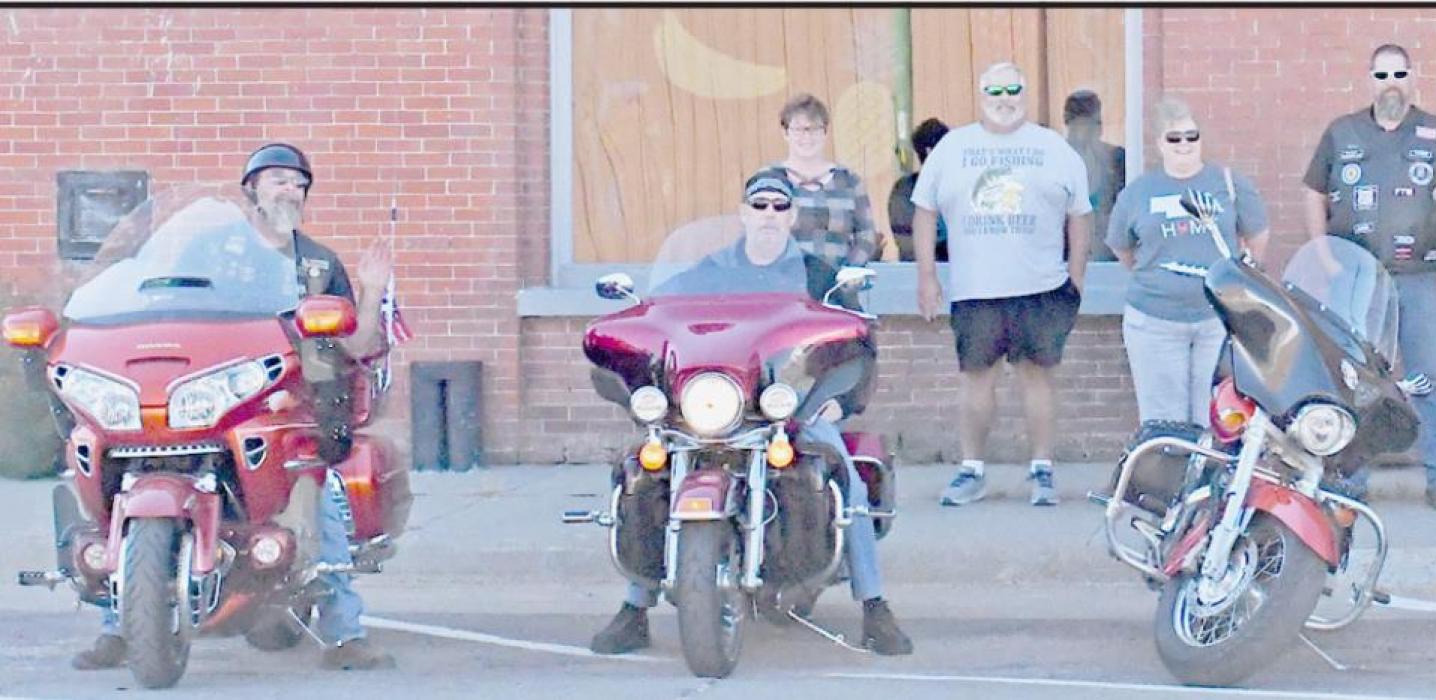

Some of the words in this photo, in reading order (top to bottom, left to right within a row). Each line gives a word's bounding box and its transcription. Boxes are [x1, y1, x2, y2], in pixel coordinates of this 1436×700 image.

[961, 155, 967, 168] I
[970, 155, 987, 167] GO
[990, 155, 1045, 167] FISHING
